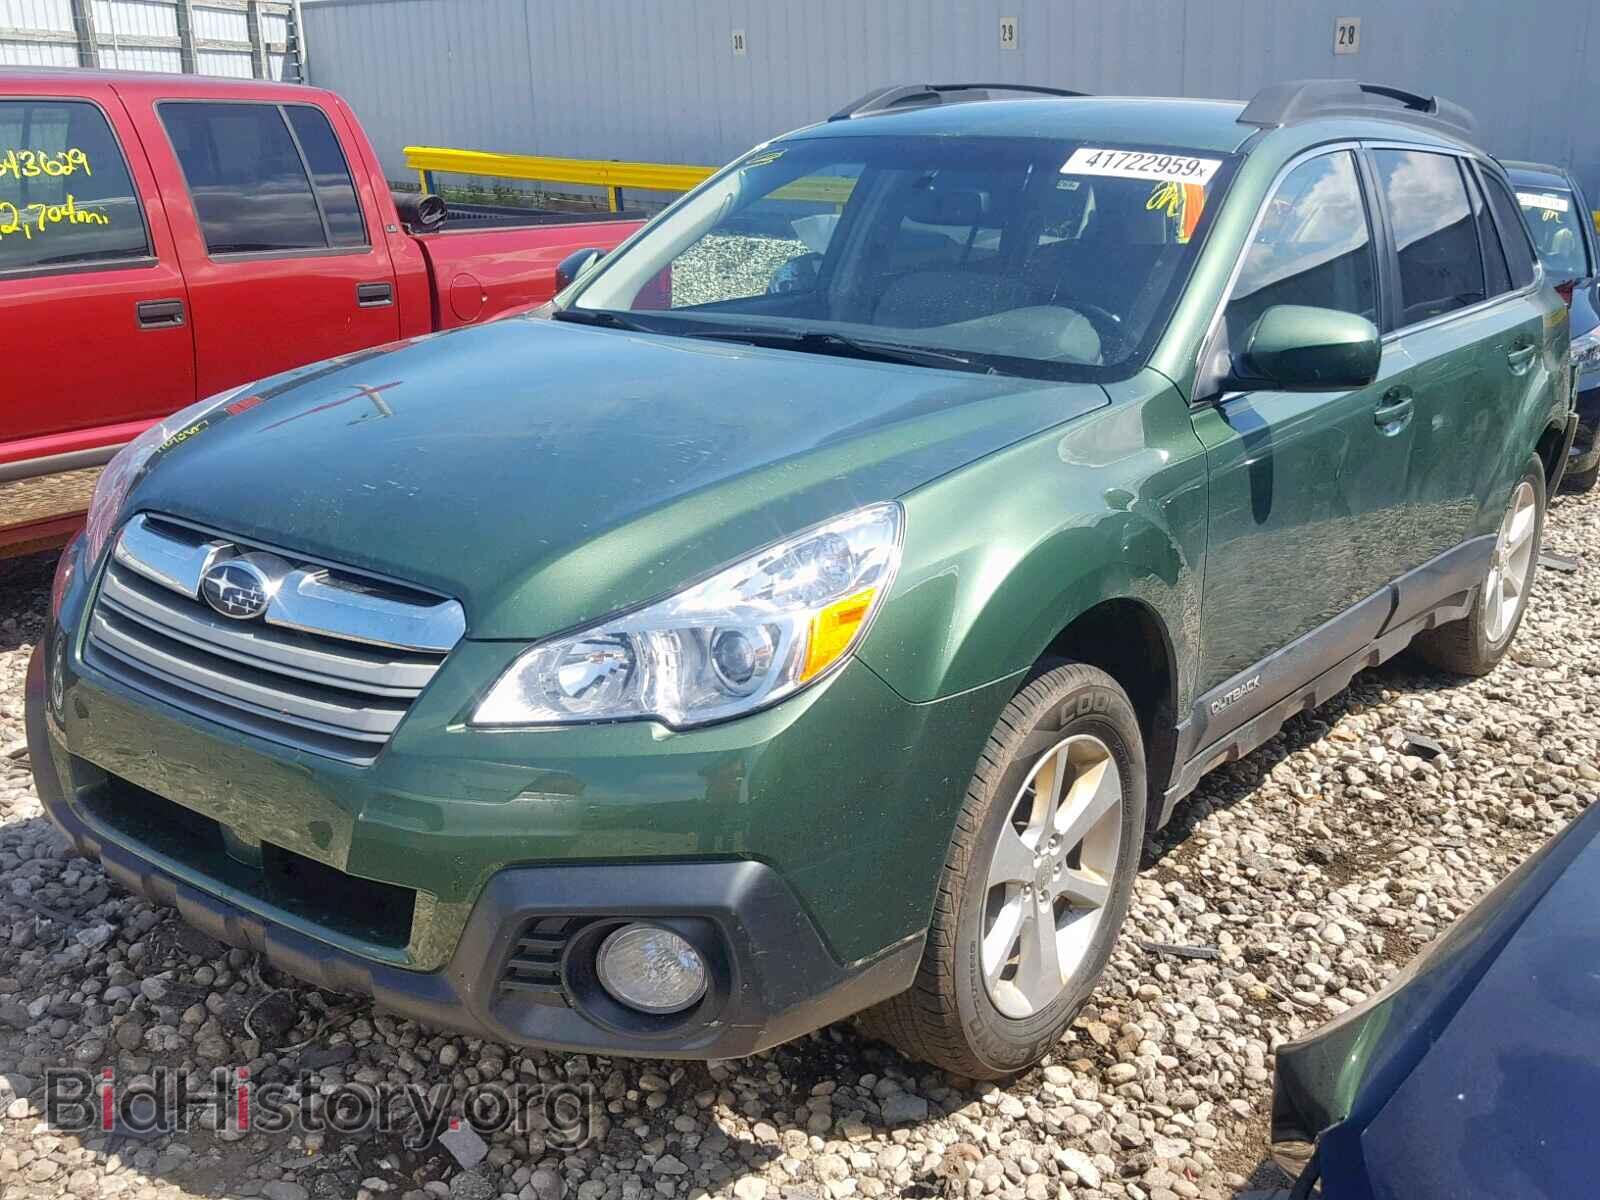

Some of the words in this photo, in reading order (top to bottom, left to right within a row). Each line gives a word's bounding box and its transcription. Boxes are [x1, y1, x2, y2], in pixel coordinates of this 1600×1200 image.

[1001, 24, 1014, 42] 29
[1338, 25, 1355, 45] 28
[1211, 674, 1261, 714] OUTBACK
